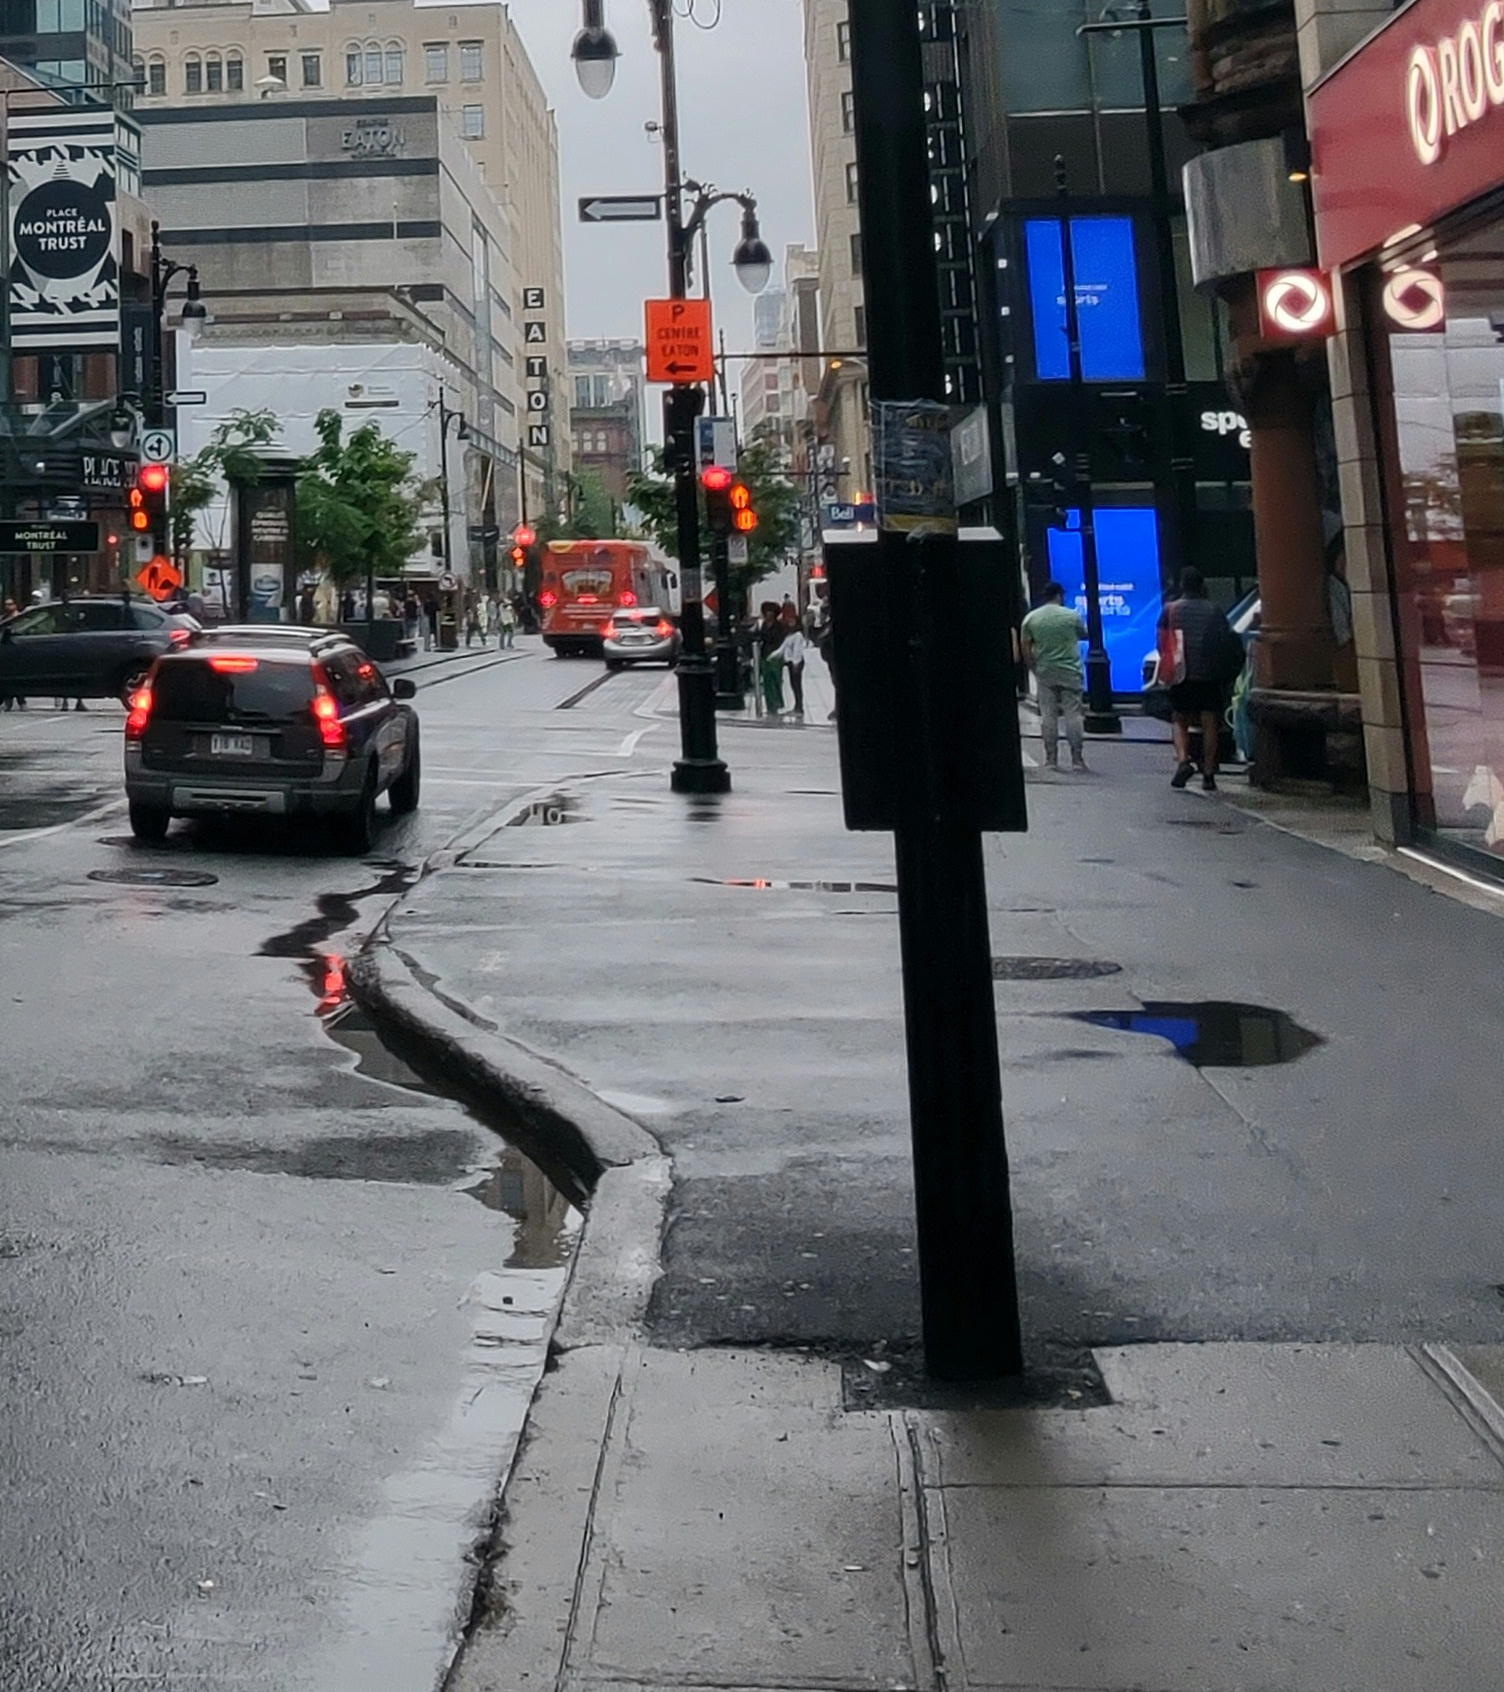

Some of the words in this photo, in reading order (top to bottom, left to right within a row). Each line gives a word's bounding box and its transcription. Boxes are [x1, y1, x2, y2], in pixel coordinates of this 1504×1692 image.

[46, 208, 78, 217] PLACE
[38, 236, 87, 251] TRUST
[657, 327, 700, 340] CENTRE
[527, 289, 548, 445] EATON
